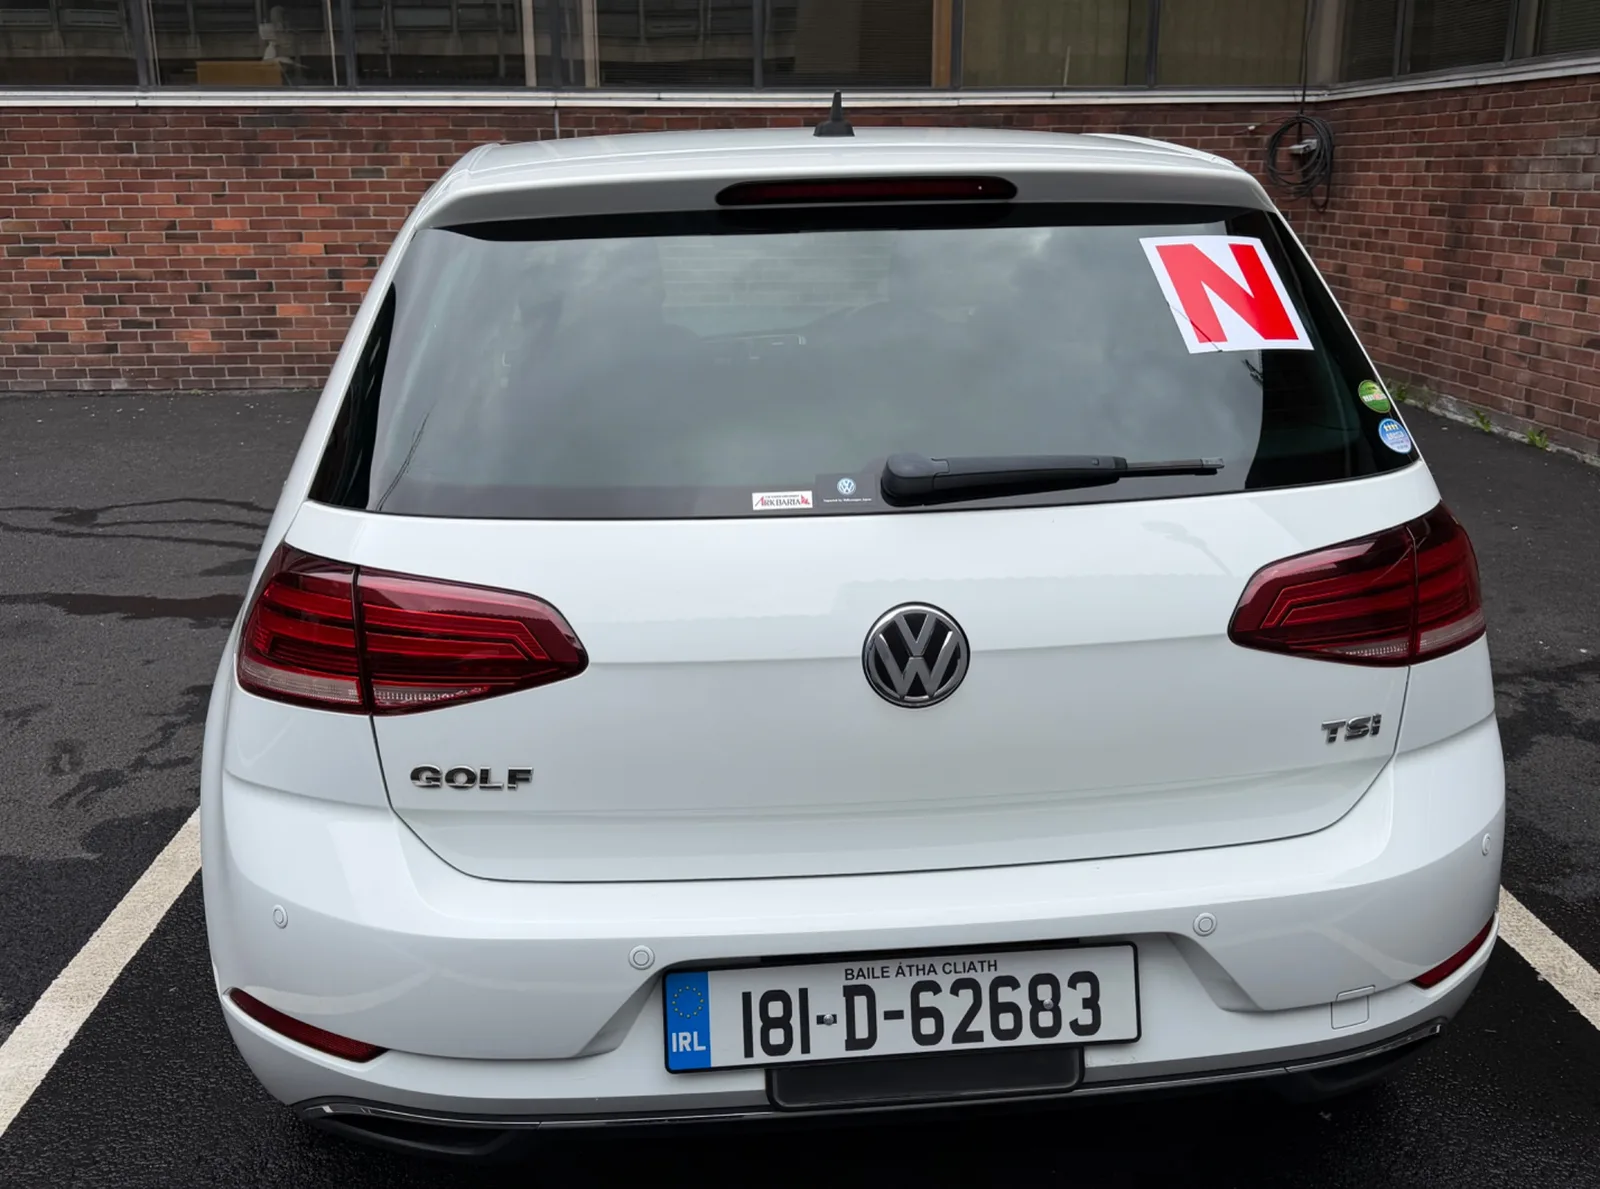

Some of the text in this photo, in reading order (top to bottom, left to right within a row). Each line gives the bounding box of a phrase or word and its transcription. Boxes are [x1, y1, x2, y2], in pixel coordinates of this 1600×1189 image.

[1155, 243, 1299, 343] N
[410, 764, 533, 790] GOLF
[844, 959, 998, 981] BAILE ÁTHA CLIATH
[741, 970, 1102, 1059] 181-D-62683
[671, 1031, 707, 1052] IRL
